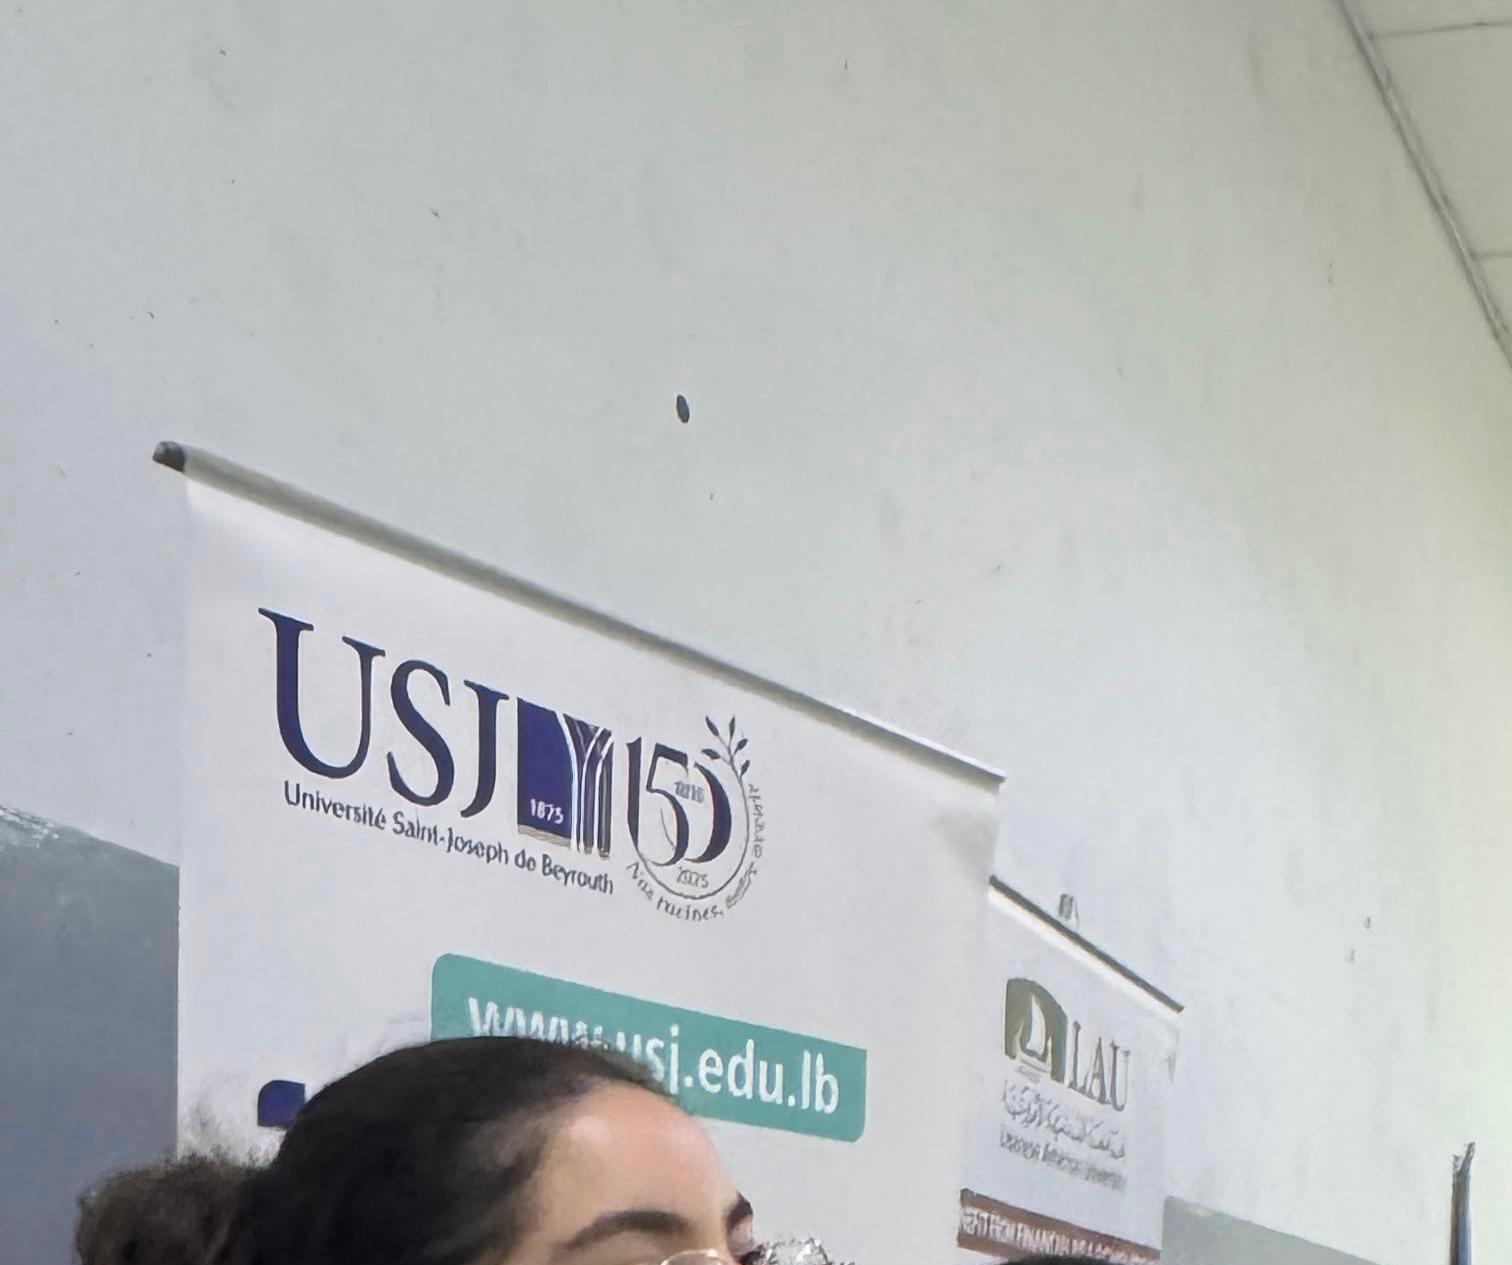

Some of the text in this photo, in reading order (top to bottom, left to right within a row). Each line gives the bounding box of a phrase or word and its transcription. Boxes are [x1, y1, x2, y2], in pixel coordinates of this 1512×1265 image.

[257, 607, 509, 818] USJ
[284, 779, 387, 830] Université
[392, 811, 509, 864] Saint-Joseph
[541, 853, 614, 895] Beyrouth
[467, 997, 840, 1114] wwwusj.edu.lb
[1068, 1020, 1131, 1111] LAU
